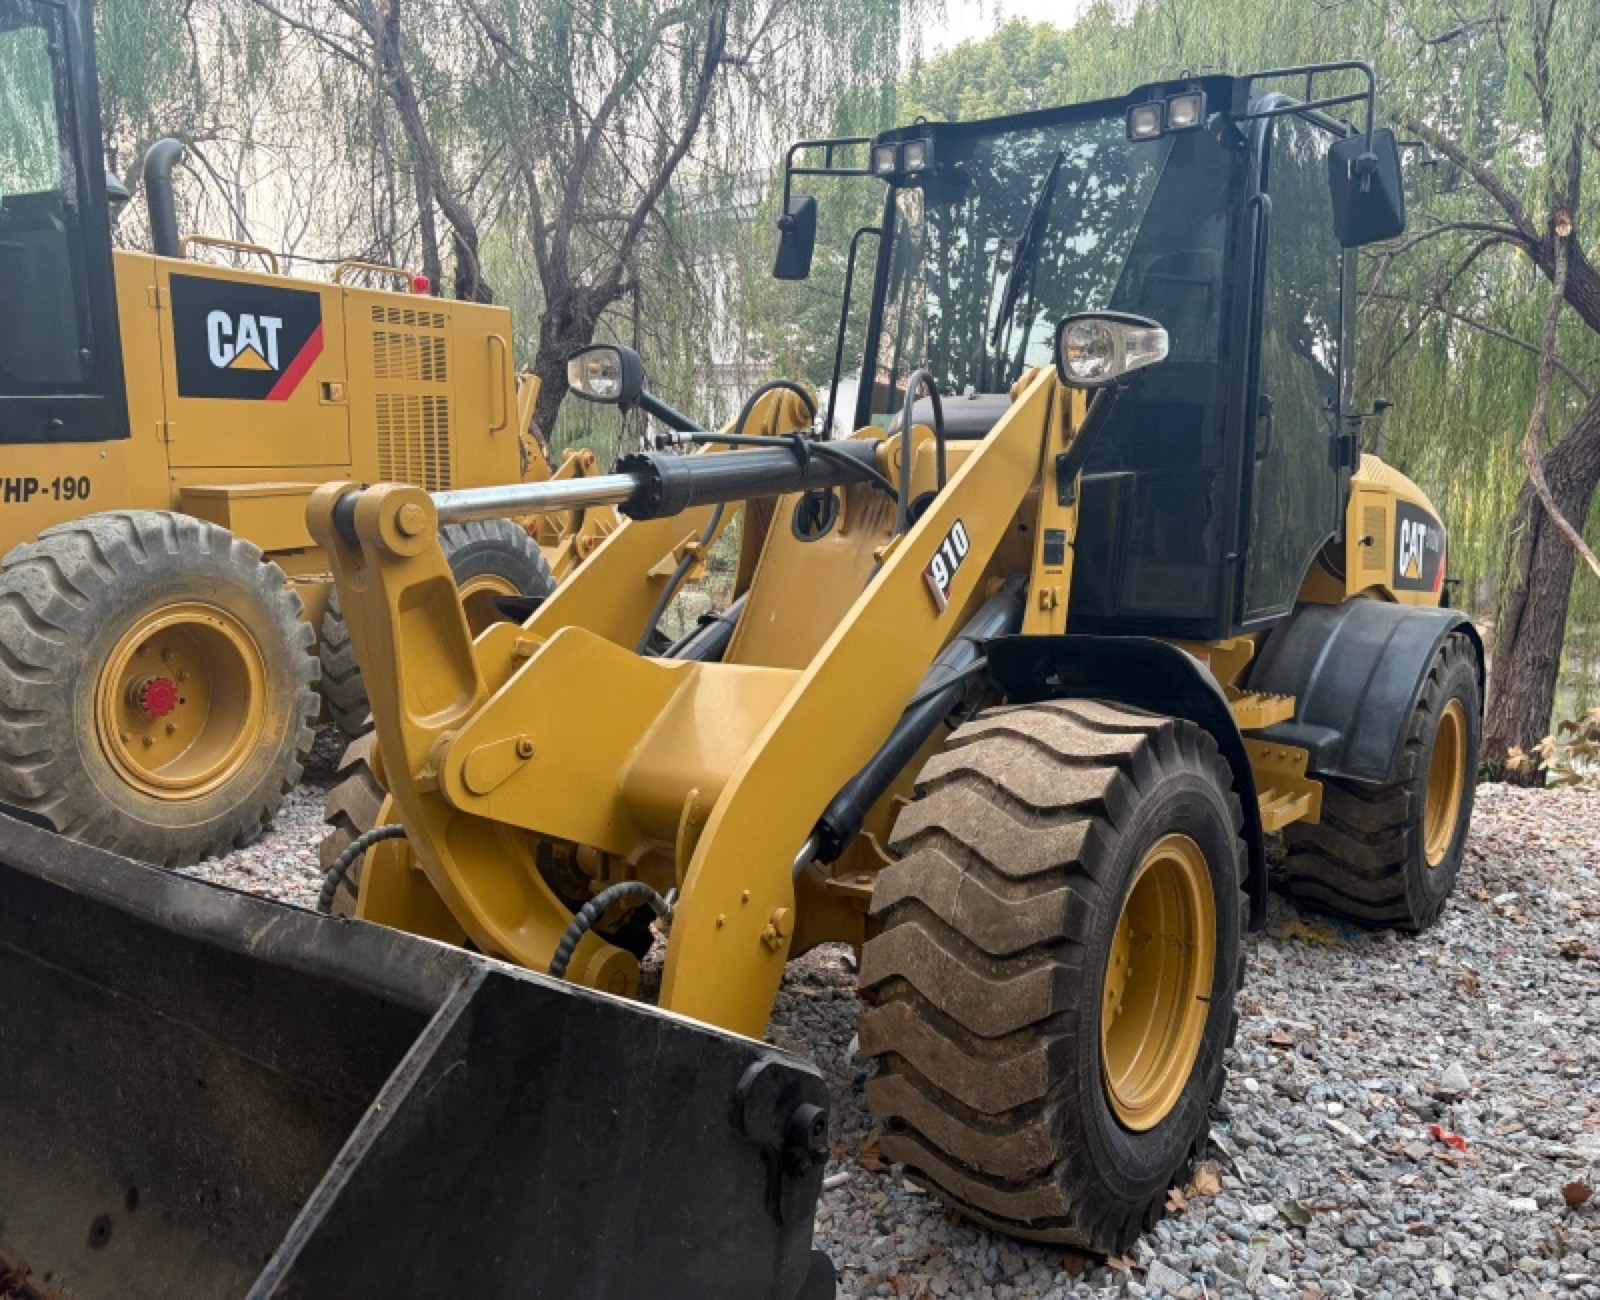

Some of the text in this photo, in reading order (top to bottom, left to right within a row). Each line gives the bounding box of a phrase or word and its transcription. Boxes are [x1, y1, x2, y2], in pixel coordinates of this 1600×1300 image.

[206, 309, 283, 371] CAT
[0, 476, 91, 503] HP-190
[931, 521, 969, 591] 910
[1400, 518, 1427, 578] CAT
